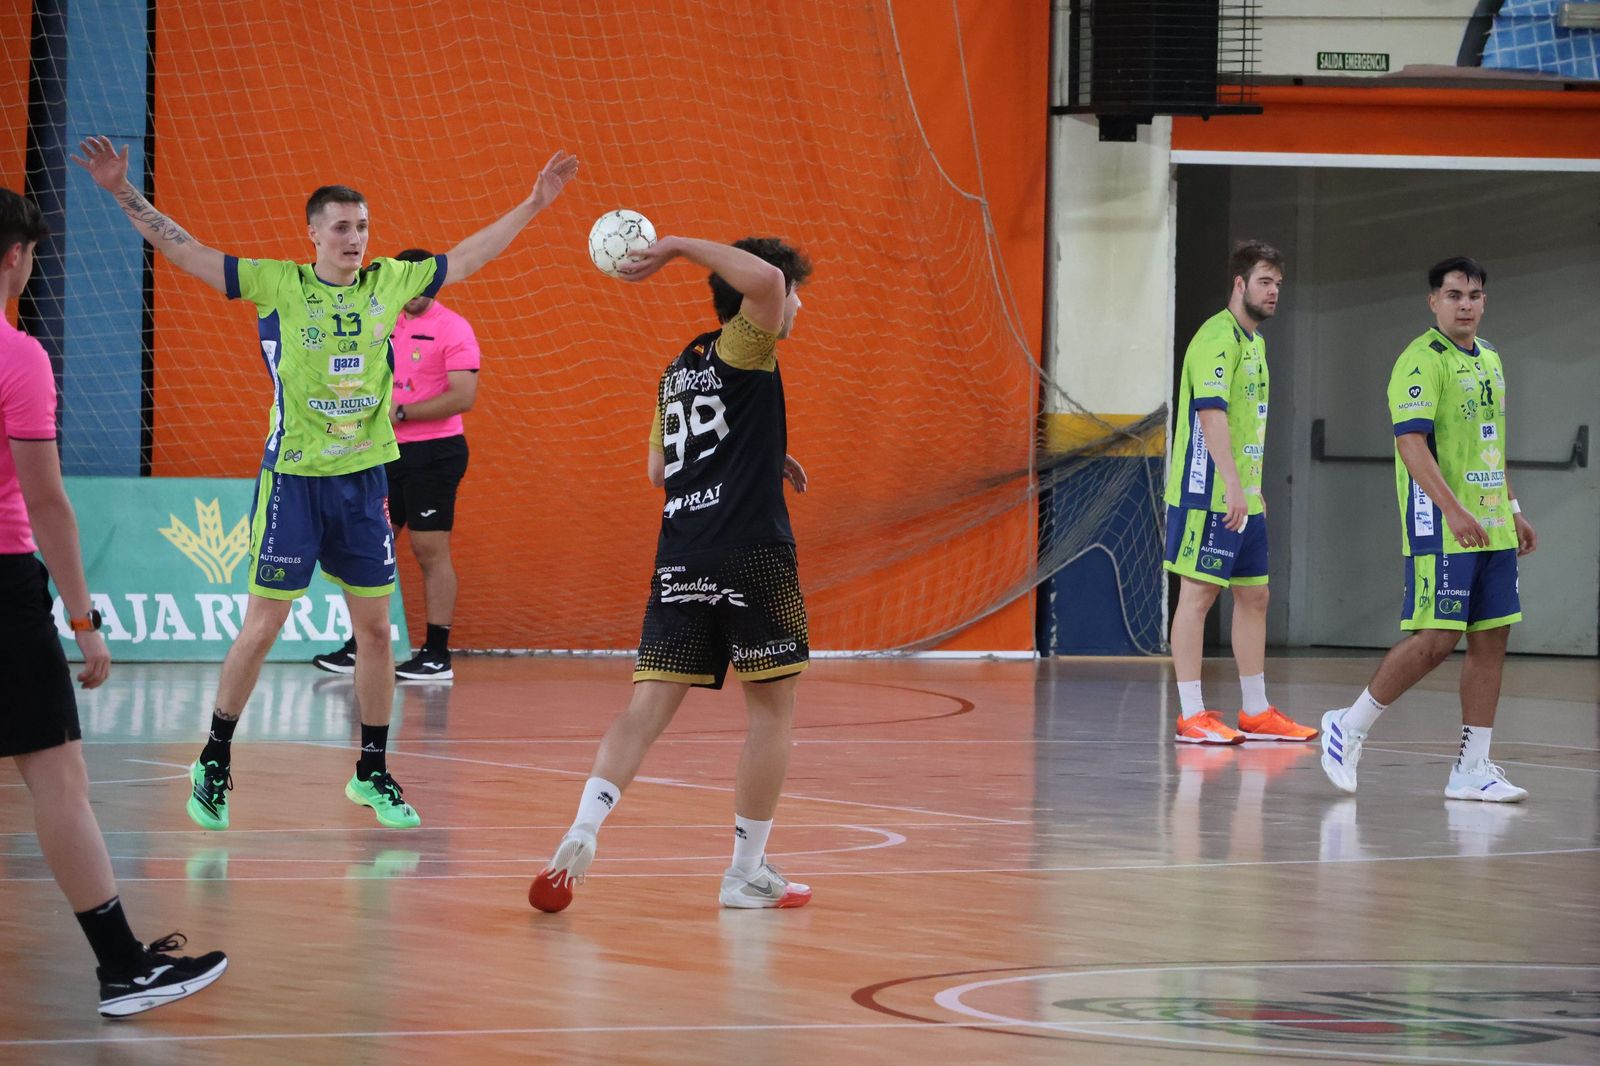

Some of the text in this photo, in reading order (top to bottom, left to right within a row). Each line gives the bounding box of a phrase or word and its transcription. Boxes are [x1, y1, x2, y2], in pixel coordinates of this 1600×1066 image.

[1320, 53, 1387, 70] SALIDA EMERGENCIA
[331, 312, 362, 336] 13
[334, 357, 360, 371] gaza
[309, 396, 378, 411] CAJA RURAL
[1399, 401, 1433, 409] MORALEJO
[664, 395, 730, 479] 99
[1482, 425, 1495, 438] ga
[1466, 472, 1490, 482] CAJA
[267, 472, 281, 553] UTORED.ES
[383, 532, 396, 566] 1
[260, 553, 302, 564] AUTORED.ES
[661, 573, 718, 597] Sanalón
[732, 641, 797, 661] GUINALDO
